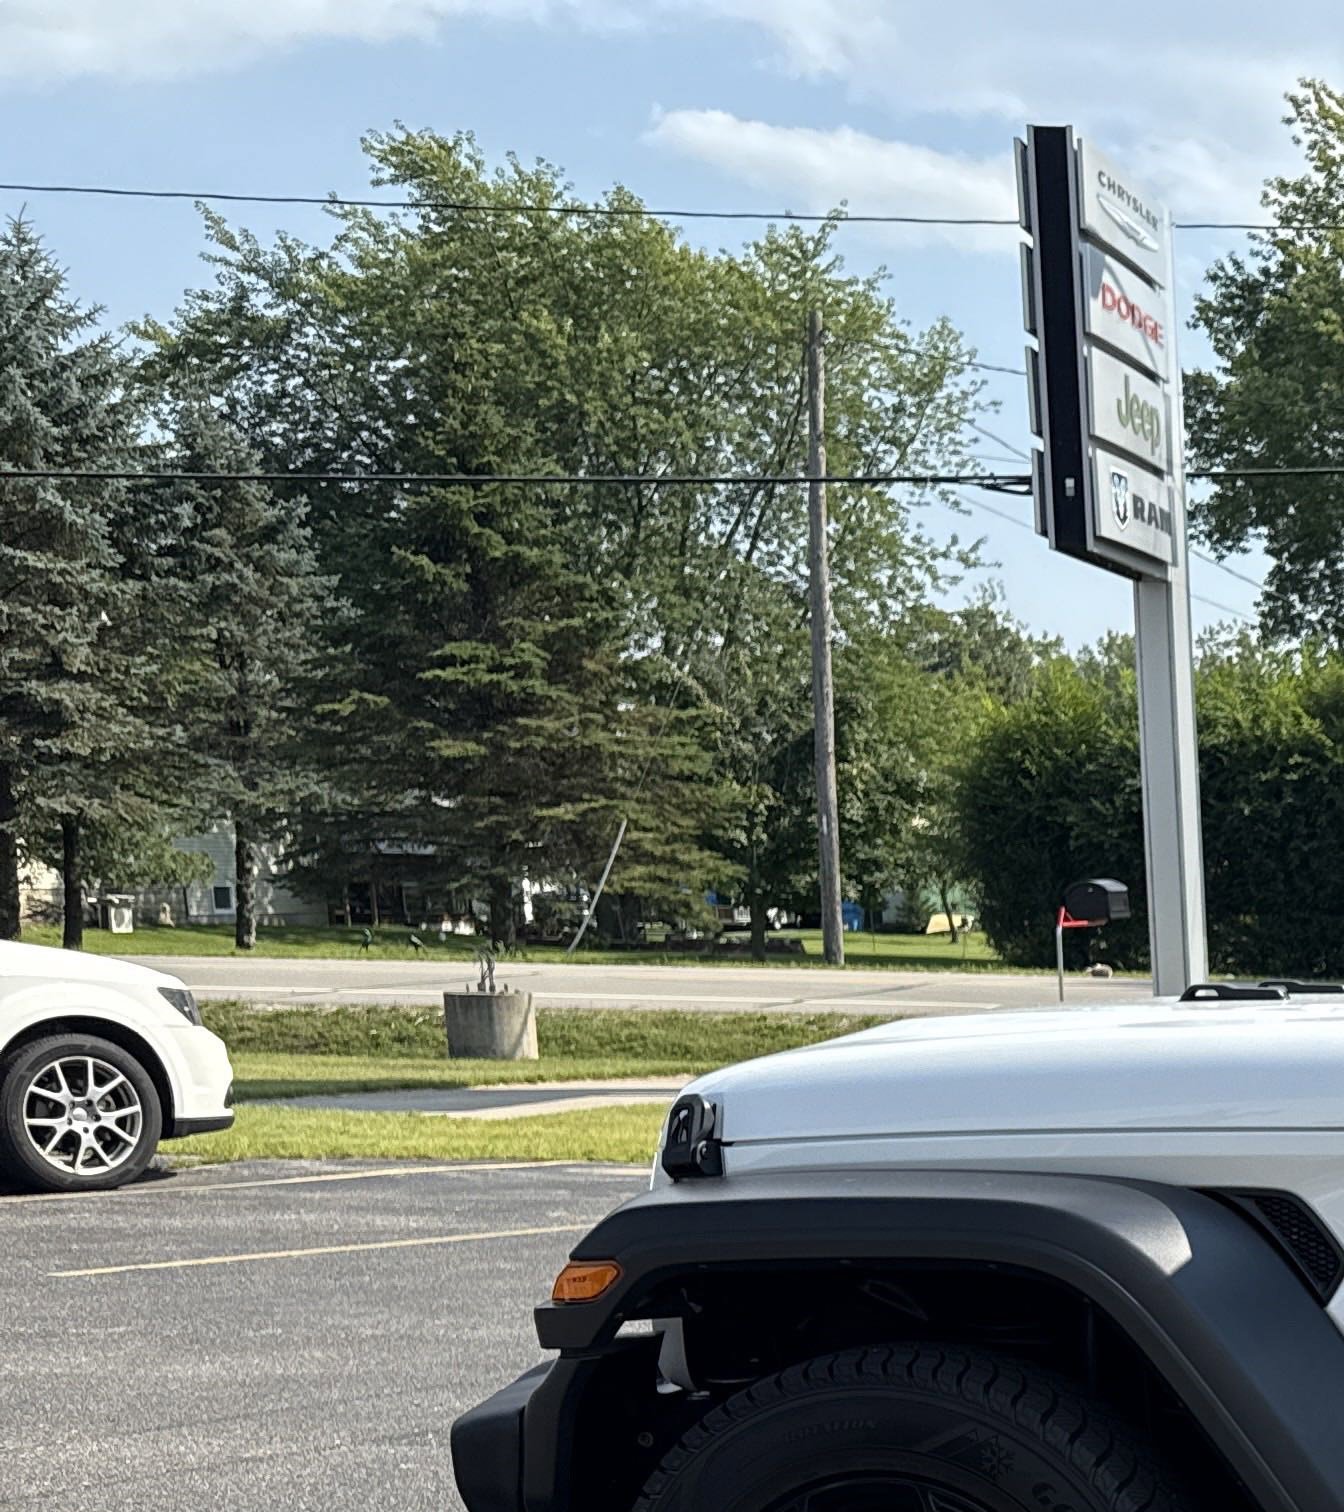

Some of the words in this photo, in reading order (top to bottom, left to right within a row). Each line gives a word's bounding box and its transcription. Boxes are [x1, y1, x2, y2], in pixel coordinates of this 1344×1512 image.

[1097, 170, 1159, 231] CHRYSLER
[1101, 282, 1165, 347] DODGE
[1116, 374, 1161, 457] Jeep
[1132, 493, 1173, 537] RAM
